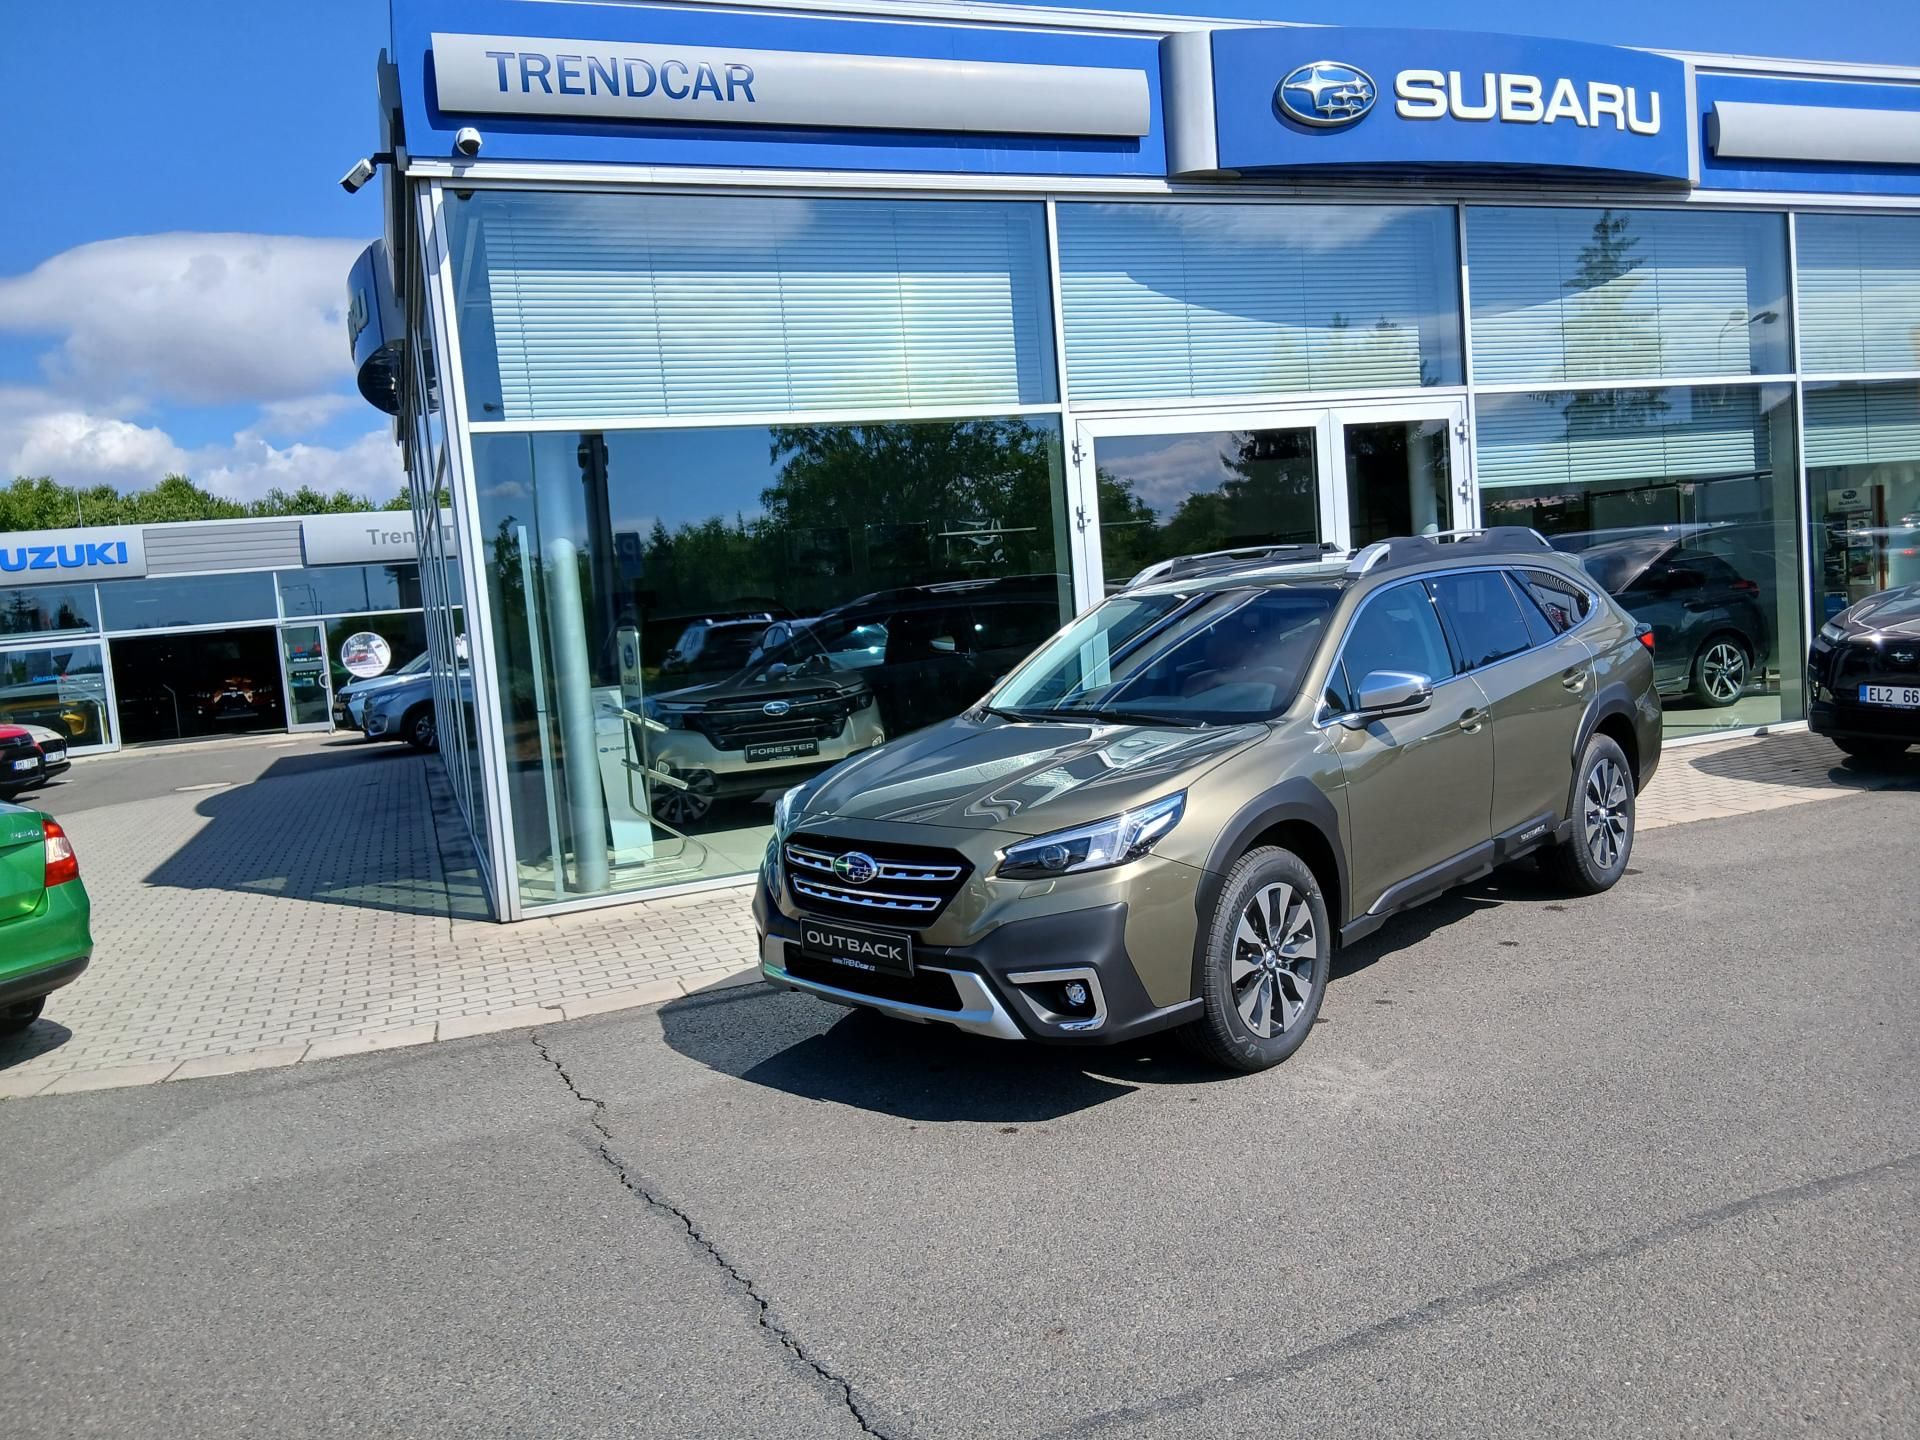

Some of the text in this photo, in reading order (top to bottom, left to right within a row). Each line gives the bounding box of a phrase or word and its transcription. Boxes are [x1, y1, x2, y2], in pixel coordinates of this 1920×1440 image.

[485, 50, 756, 103] TRENDCAR
[1394, 69, 1660, 136] SUBARU
[1869, 687, 1920, 704] EL2 66
[749, 742, 814, 757] FORESTER
[806, 930, 903, 961] OUTBACK
